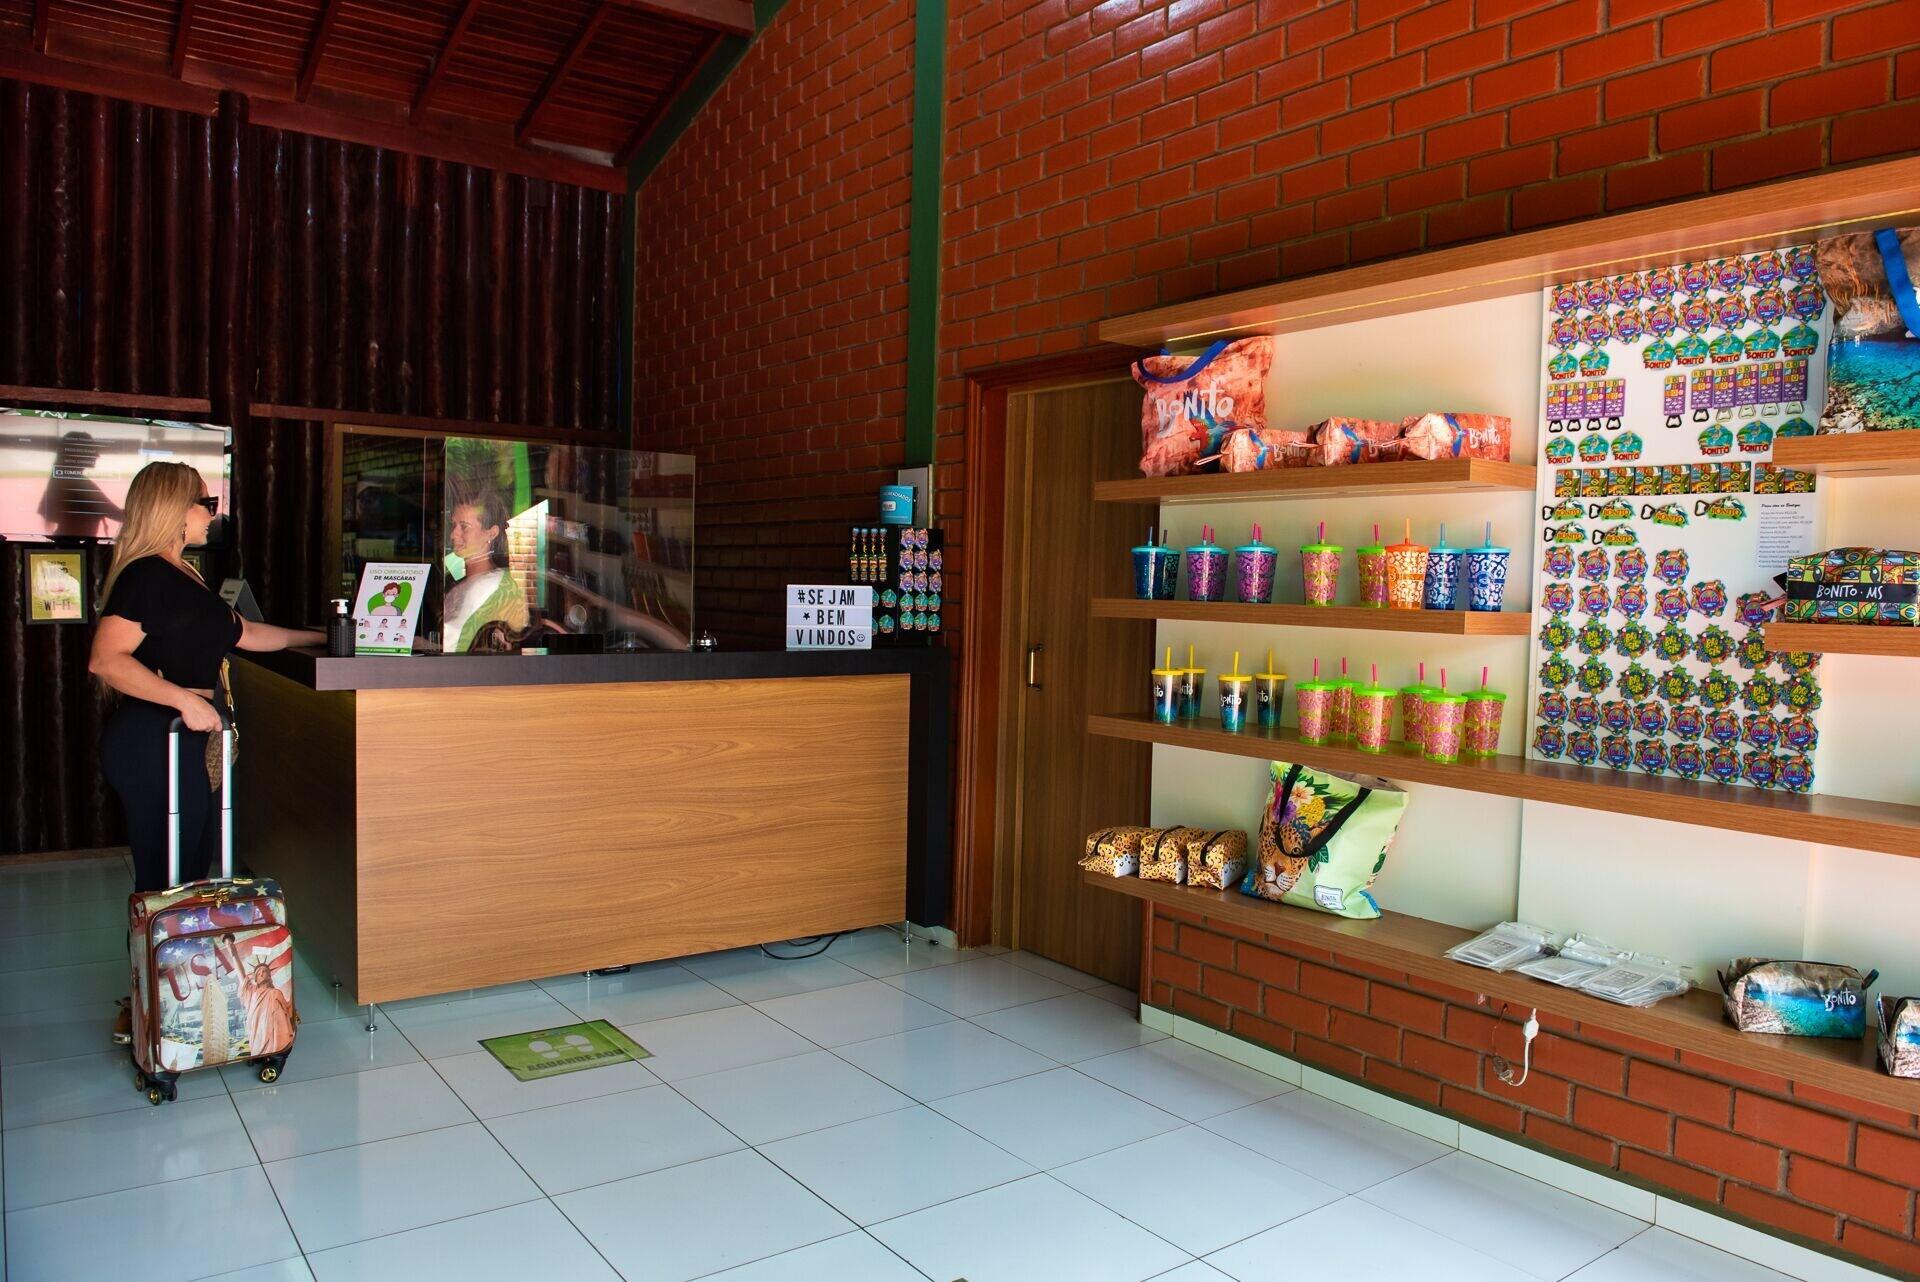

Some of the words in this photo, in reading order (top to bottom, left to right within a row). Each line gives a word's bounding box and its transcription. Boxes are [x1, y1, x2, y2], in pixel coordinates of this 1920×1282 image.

[1865, 585, 1884, 599] MS
[817, 610, 845, 625] BEM
[796, 629, 856, 646] VINDOS
[159, 953, 234, 1001] USA
[526, 1055, 593, 1071] AGUARDE
